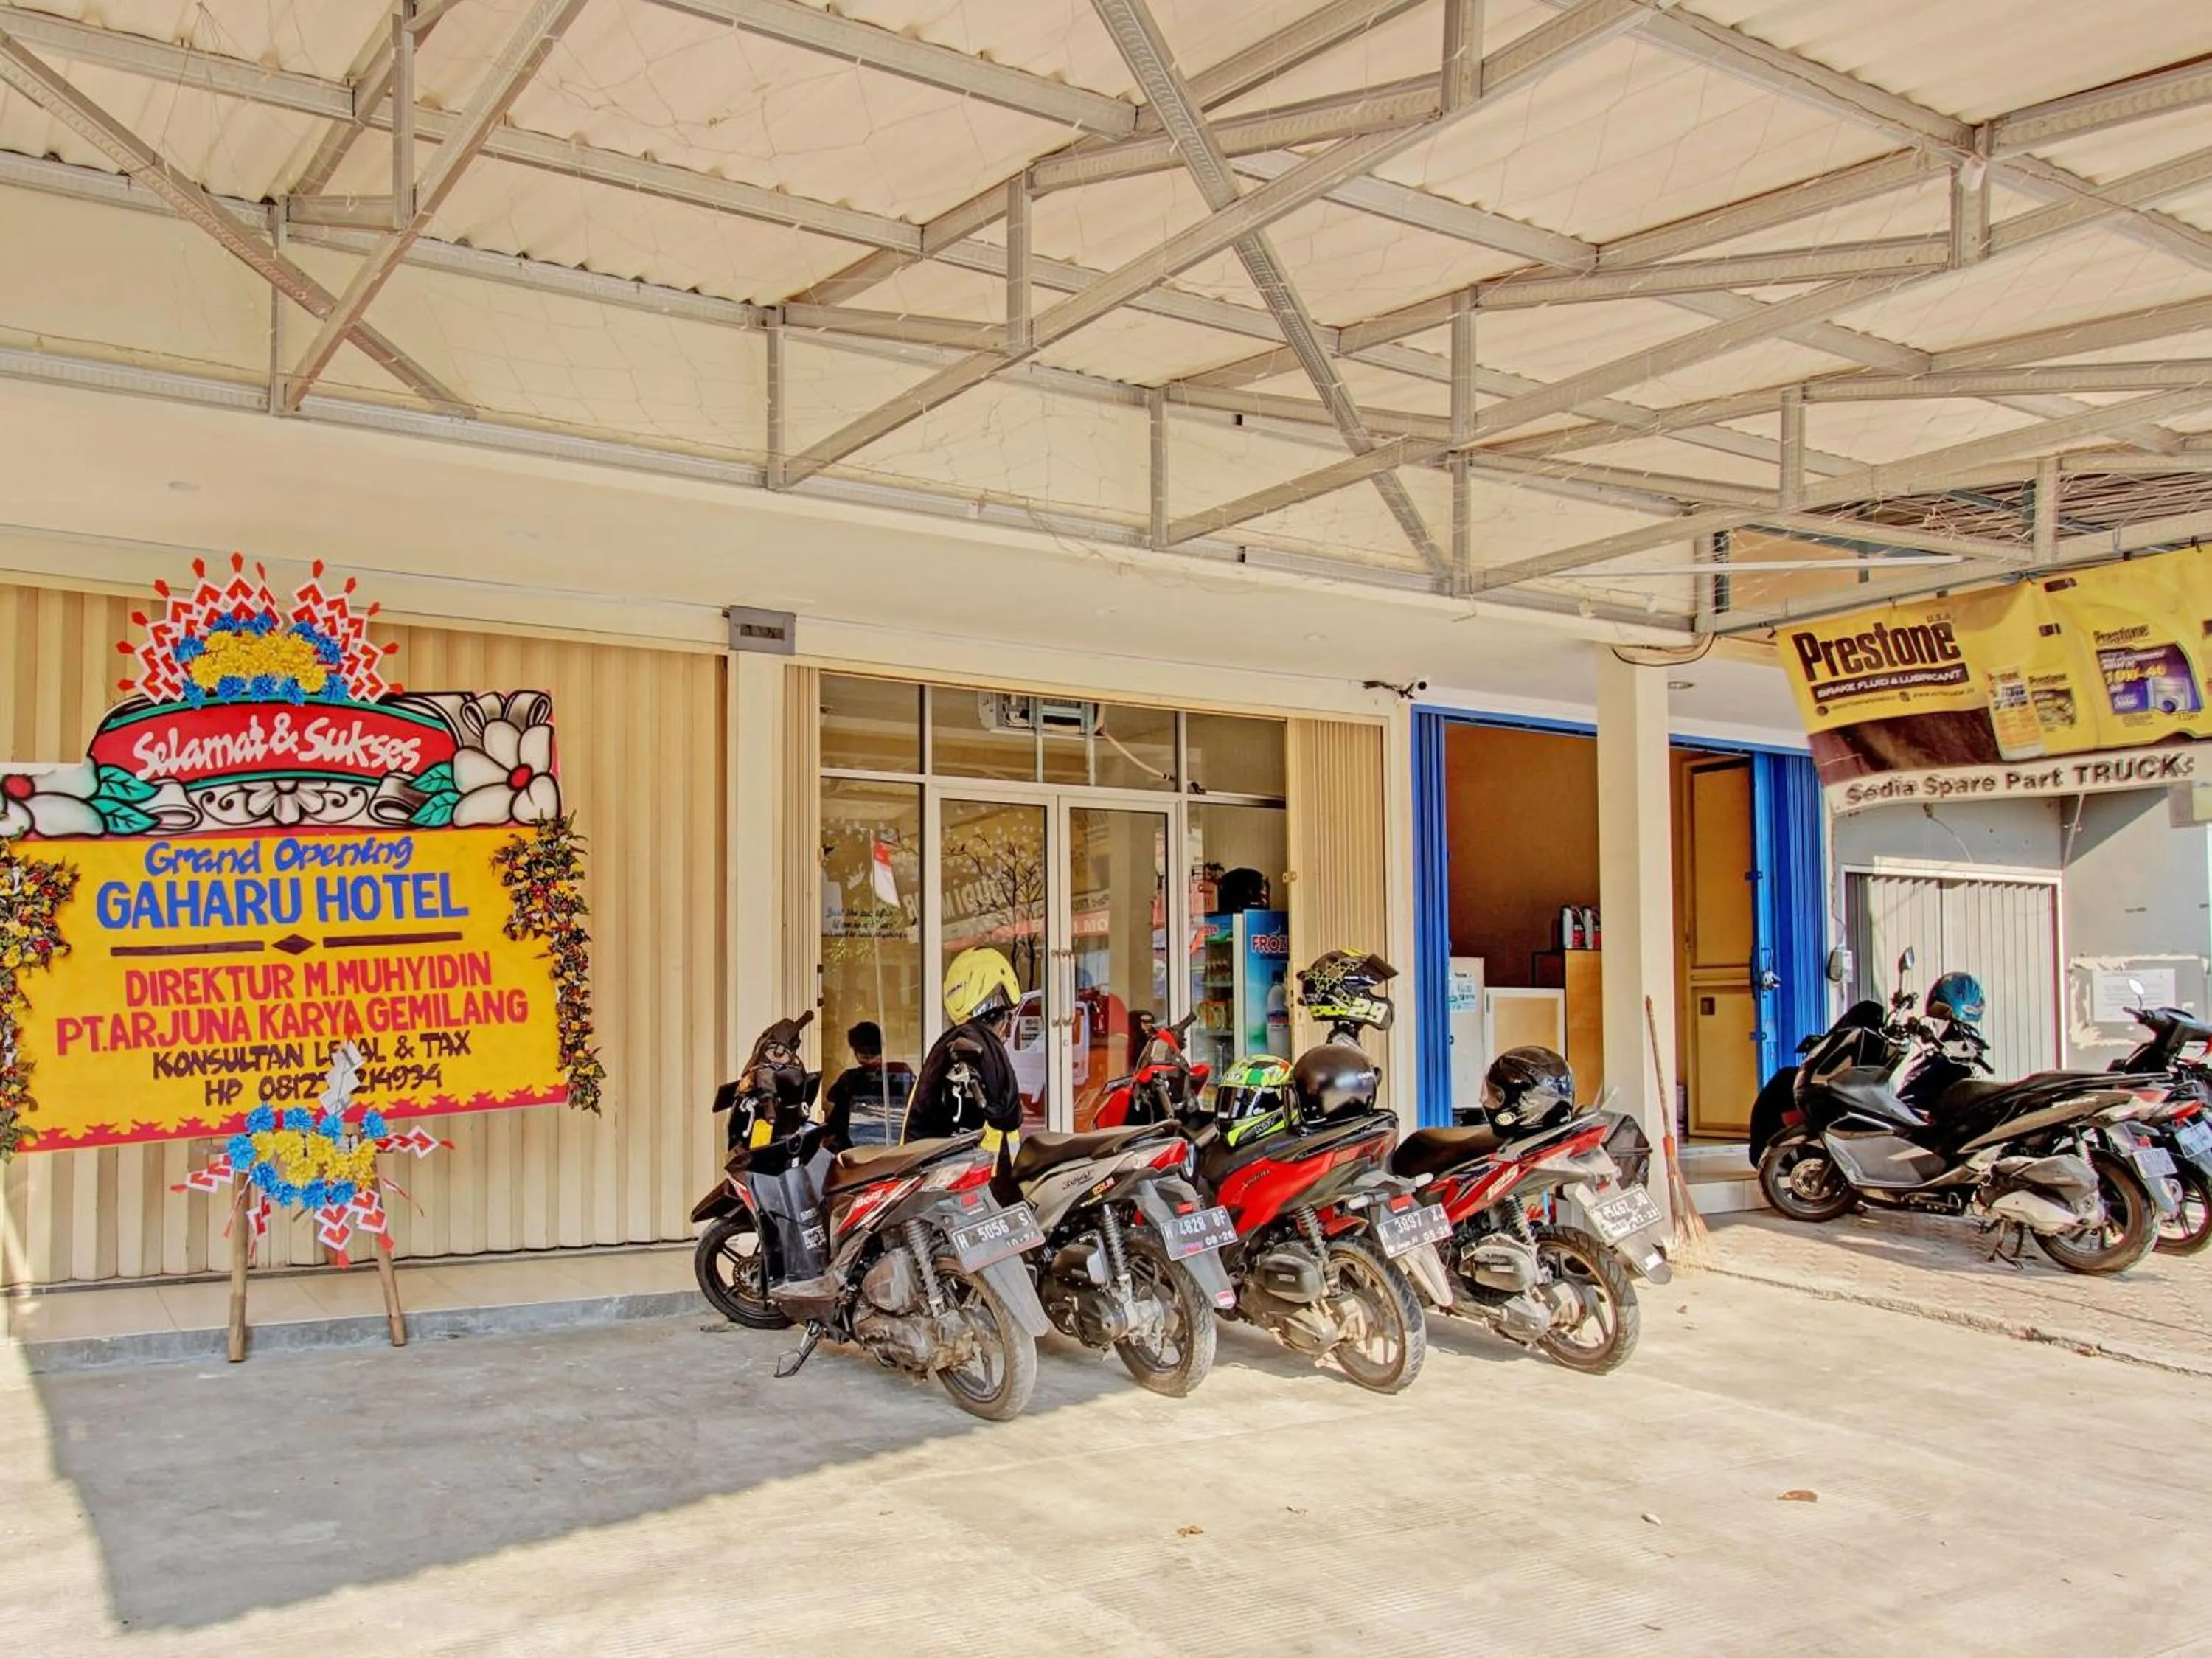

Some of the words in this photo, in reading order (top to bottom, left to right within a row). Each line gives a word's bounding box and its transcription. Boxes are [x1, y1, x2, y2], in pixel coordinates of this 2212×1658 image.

[1792, 622, 1961, 682] Prestone
[1816, 682, 1857, 699] BRAKE
[1857, 677, 1889, 692] FLUID
[1899, 668, 1963, 684] LUBRICANT
[133, 715, 270, 780] Selamat
[269, 712, 299, 755] &
[298, 717, 422, 771] Sukses
[1846, 782, 1915, 805] Sedia
[1922, 774, 1996, 799] Spare
[2005, 767, 2064, 789] Part
[145, 839, 262, 876] Grand
[274, 836, 414, 872] Opening
[96, 876, 302, 929] GAHARU
[316, 872, 470, 922] HOTEL
[125, 963, 296, 1007] DIREKTUR
[56, 1005, 253, 1056] PT.ARJUNA
[258, 999, 365, 1041] KARYA
[366, 988, 529, 1033] GEMILANG
[153, 1041, 305, 1080] KONSULTAN
[314, 1036, 387, 1068] LEAL
[394, 1035, 415, 1061] &
[420, 1030, 472, 1058] TAX
[205, 1078, 243, 1106] HP
[956, 1233, 970, 1252] H
[977, 1218, 1009, 1241] 5056
[1018, 1212, 1029, 1227] S
